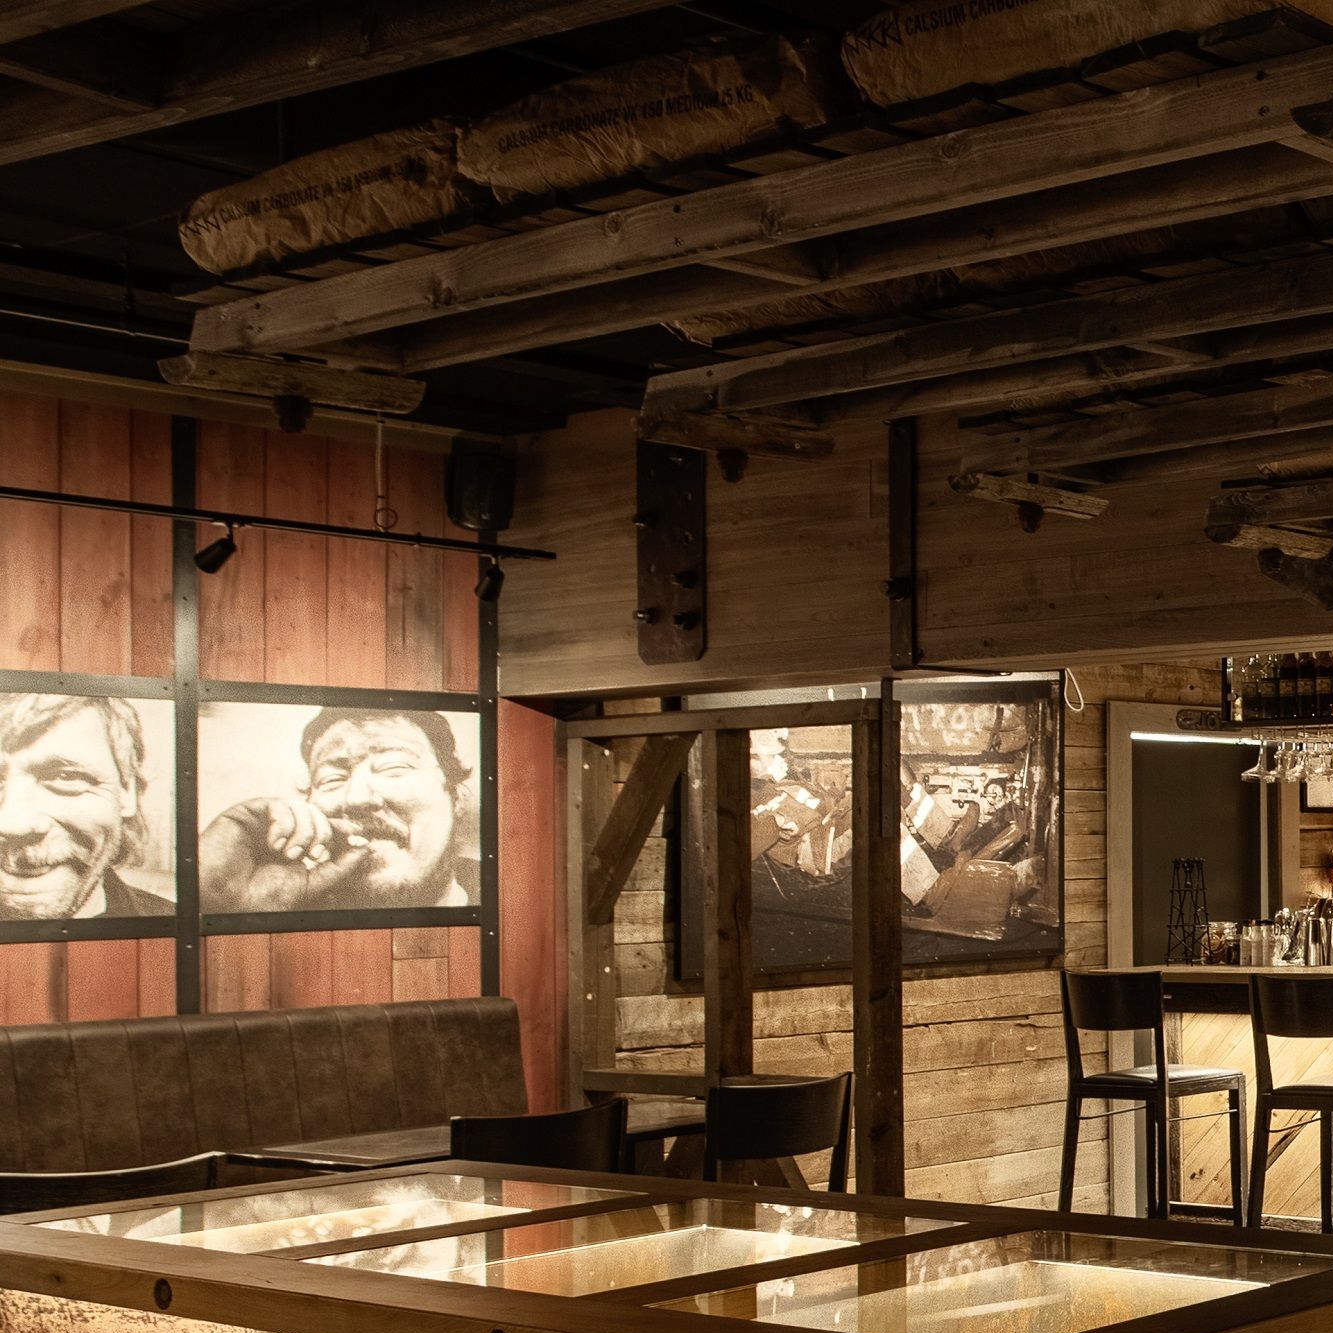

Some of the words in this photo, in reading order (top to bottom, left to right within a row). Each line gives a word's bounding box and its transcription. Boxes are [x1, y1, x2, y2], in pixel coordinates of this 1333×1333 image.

[904, 2, 968, 37] CALSIUM
[499, 128, 549, 153] CALSIUM
[550, 107, 621, 138] CARBONATE
[621, 104, 640, 125] VK
[640, 99, 664, 119] 150
[666, 92, 718, 116] MEDIUM
[736, 83, 755, 103] KG
[219, 200, 261, 225] CALSIUM
[263, 184, 321, 214] CARBONATE
